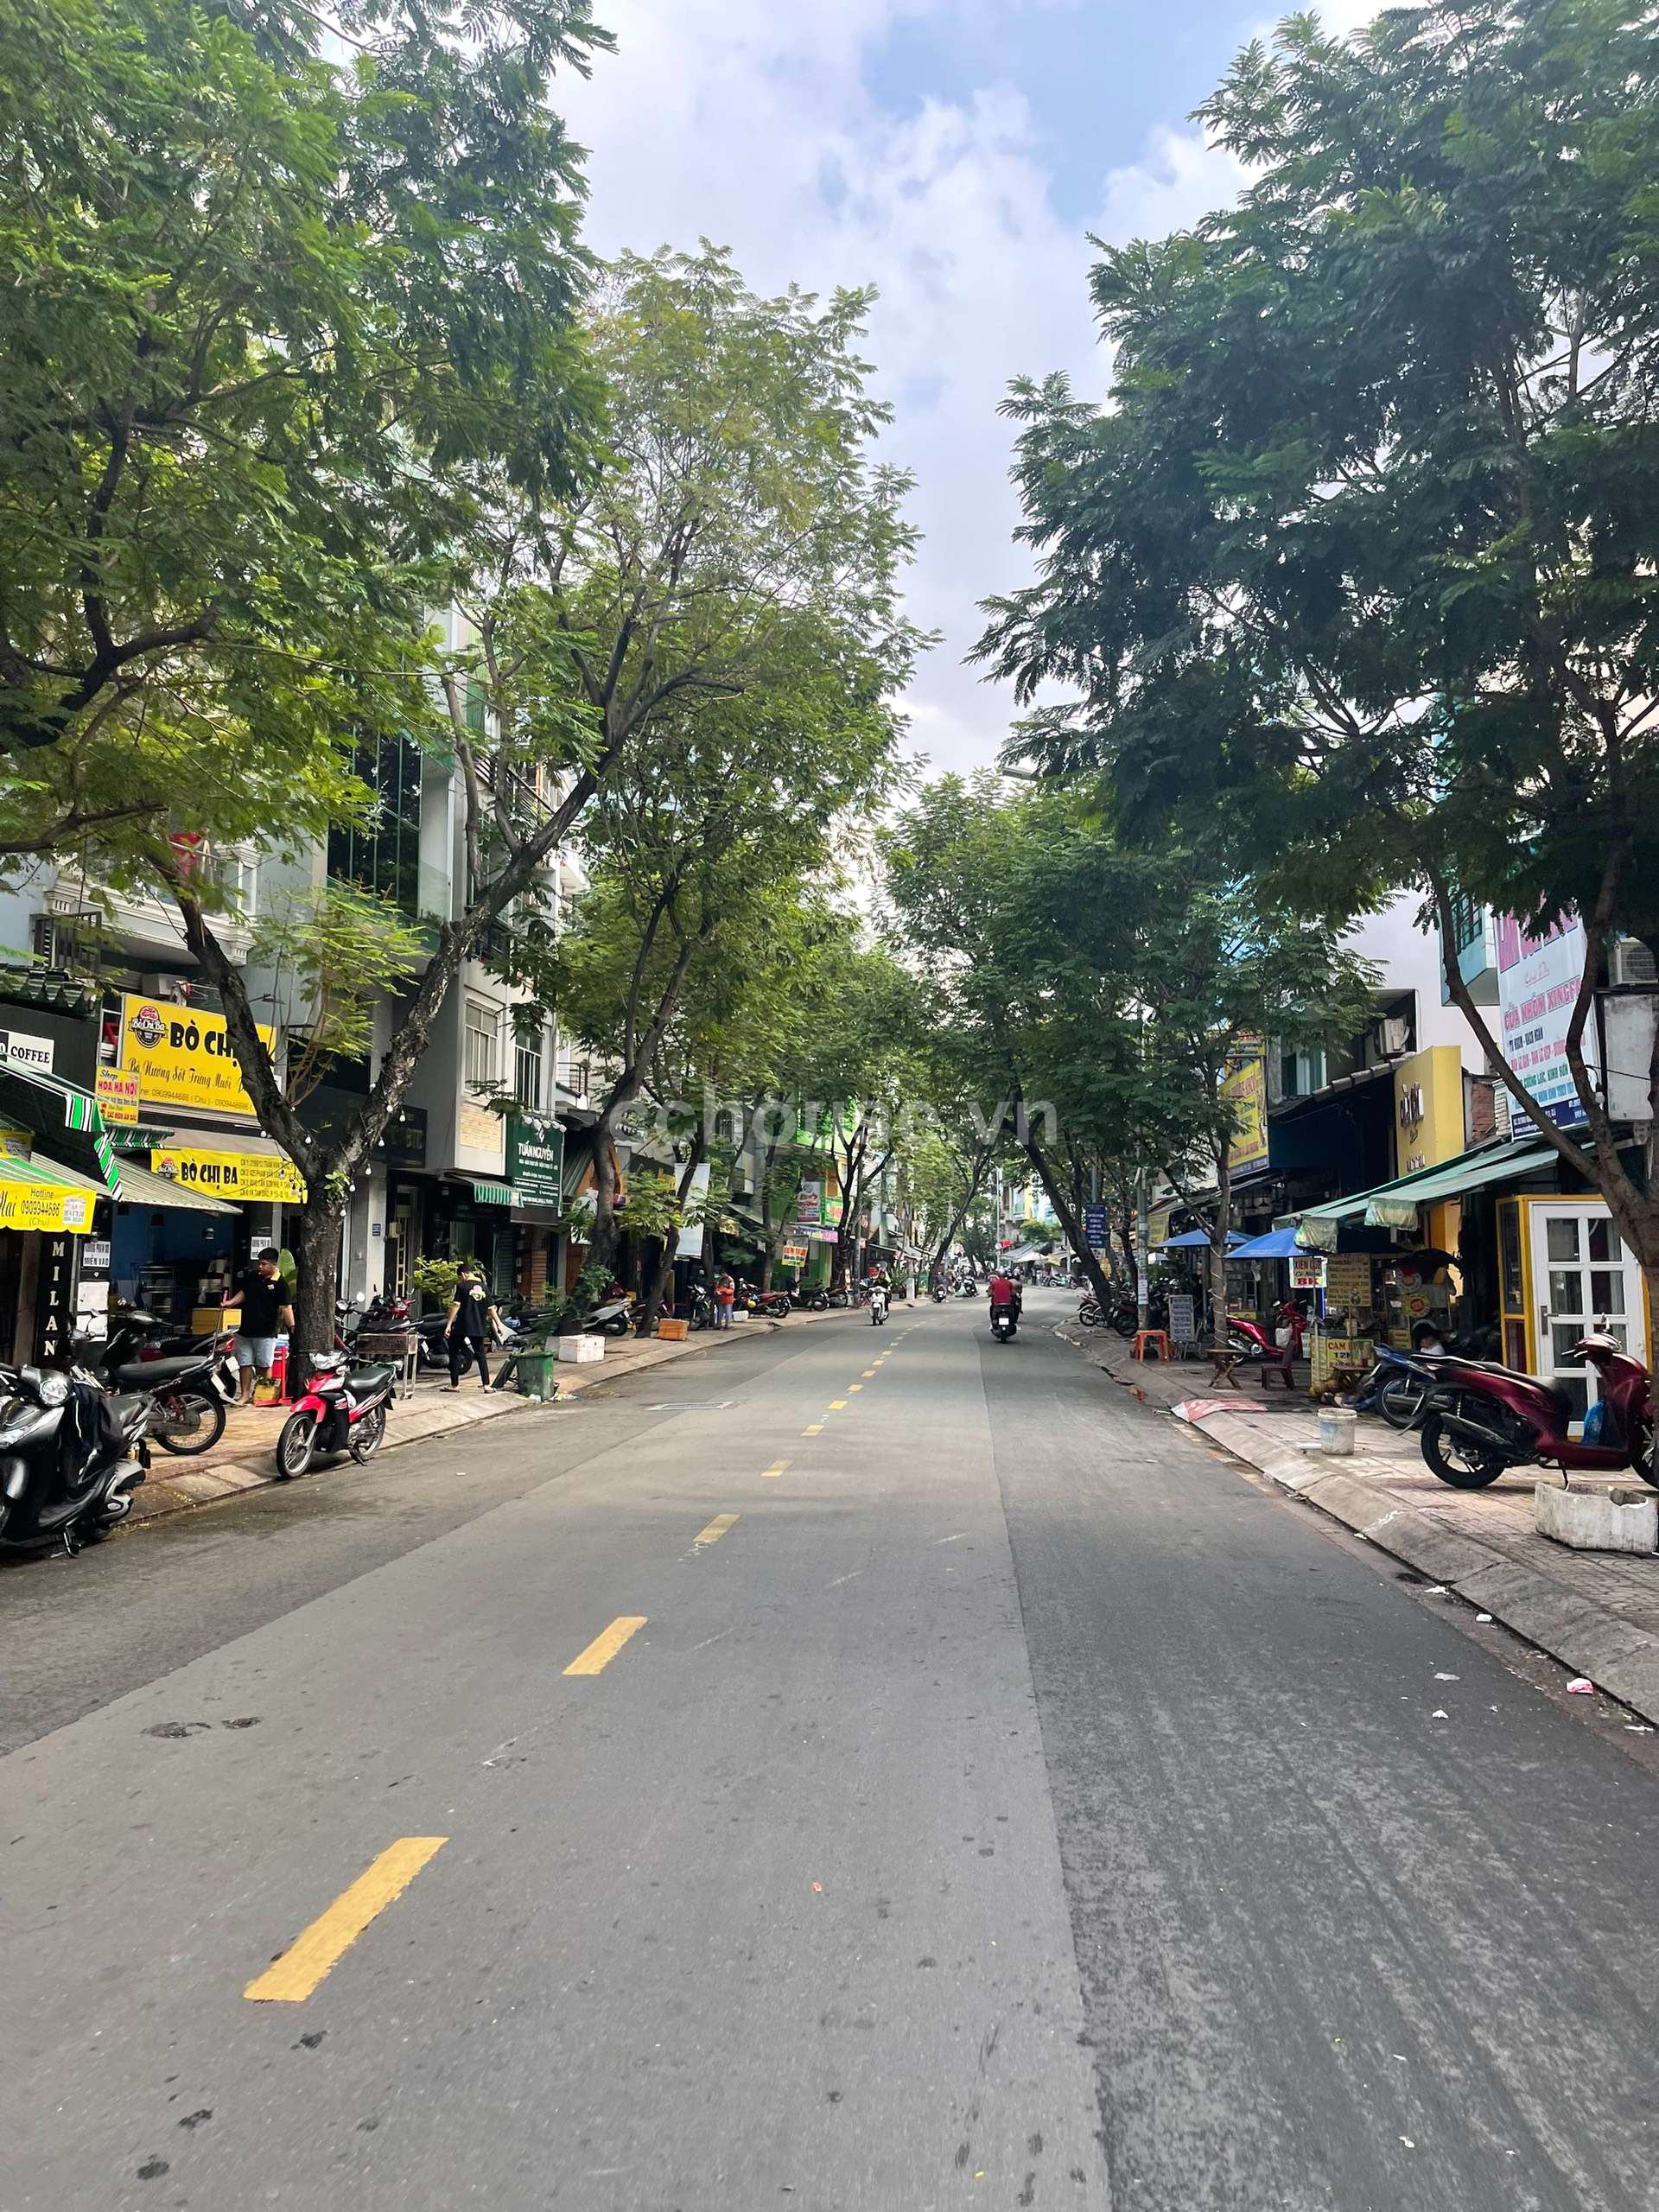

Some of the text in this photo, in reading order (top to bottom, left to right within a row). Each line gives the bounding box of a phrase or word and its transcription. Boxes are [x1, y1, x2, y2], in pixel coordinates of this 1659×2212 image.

[170, 1020, 200, 1052] BÒ
[10, 1046, 50, 1064] COFFEE
[181, 1158, 197, 1181] BÒ
[200, 1164, 220, 1190] CHỊ
[223, 1166, 238, 1185] BA
[30, 1189, 54, 1198] Hotline
[44, 1242, 65, 1356] MILAN
[1328, 1341, 1346, 1350] CAM
